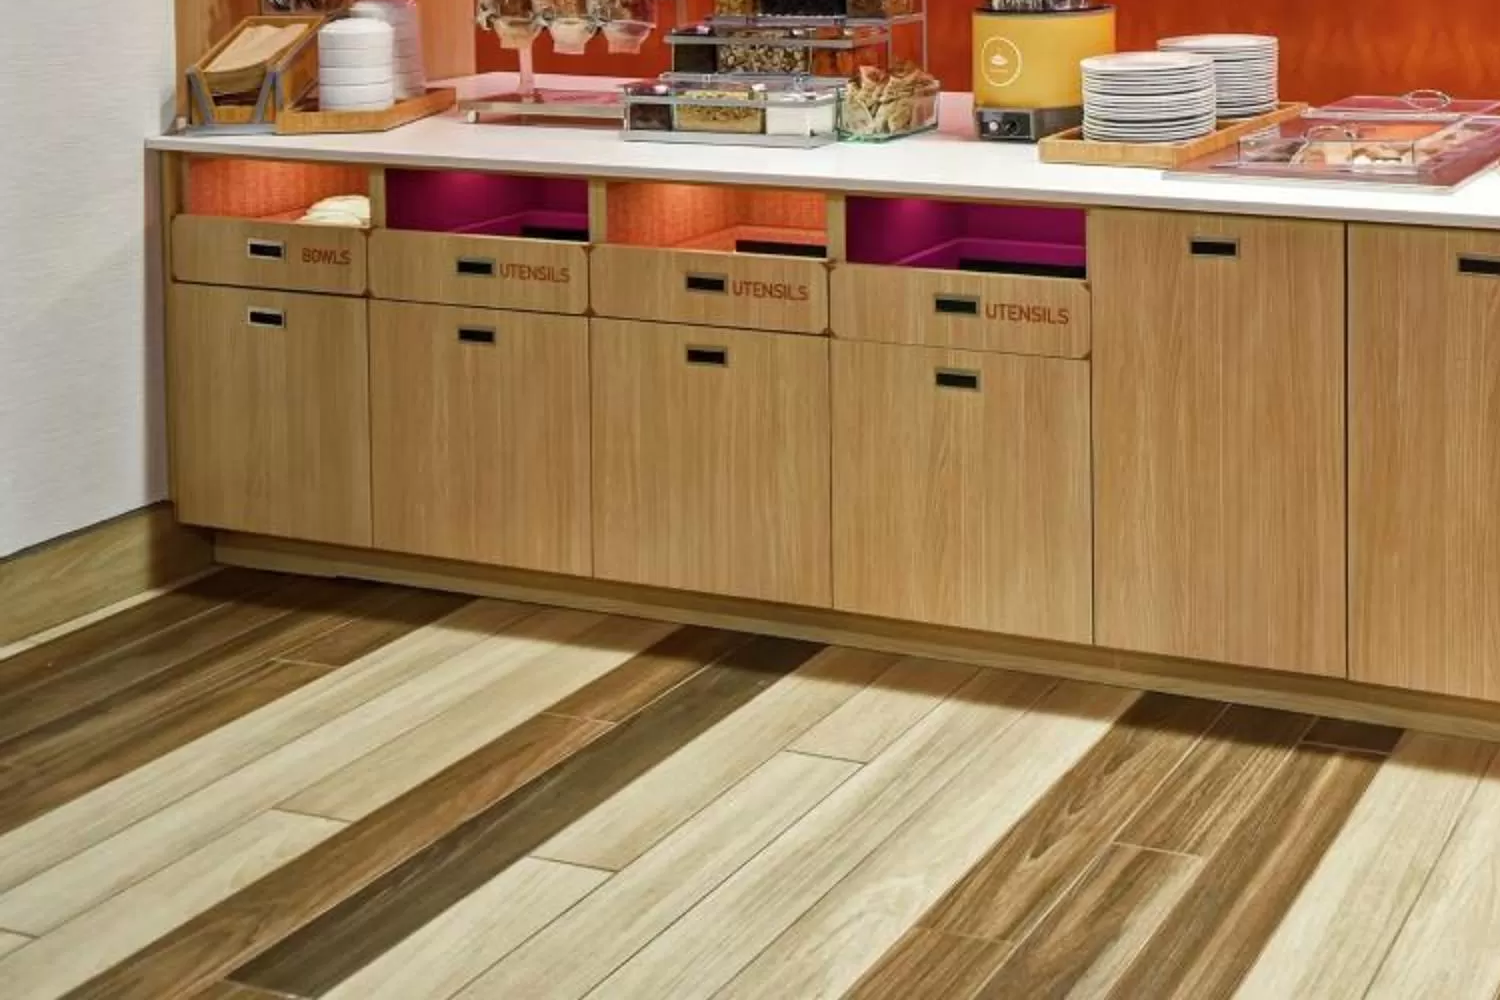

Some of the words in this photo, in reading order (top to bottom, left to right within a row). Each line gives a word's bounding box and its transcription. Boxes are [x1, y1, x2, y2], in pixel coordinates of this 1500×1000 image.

[301, 247, 352, 266] BOWLS
[499, 263, 571, 284] UTENSILS
[732, 280, 809, 301] UTENSILS
[984, 303, 1070, 325] UTENSILS
